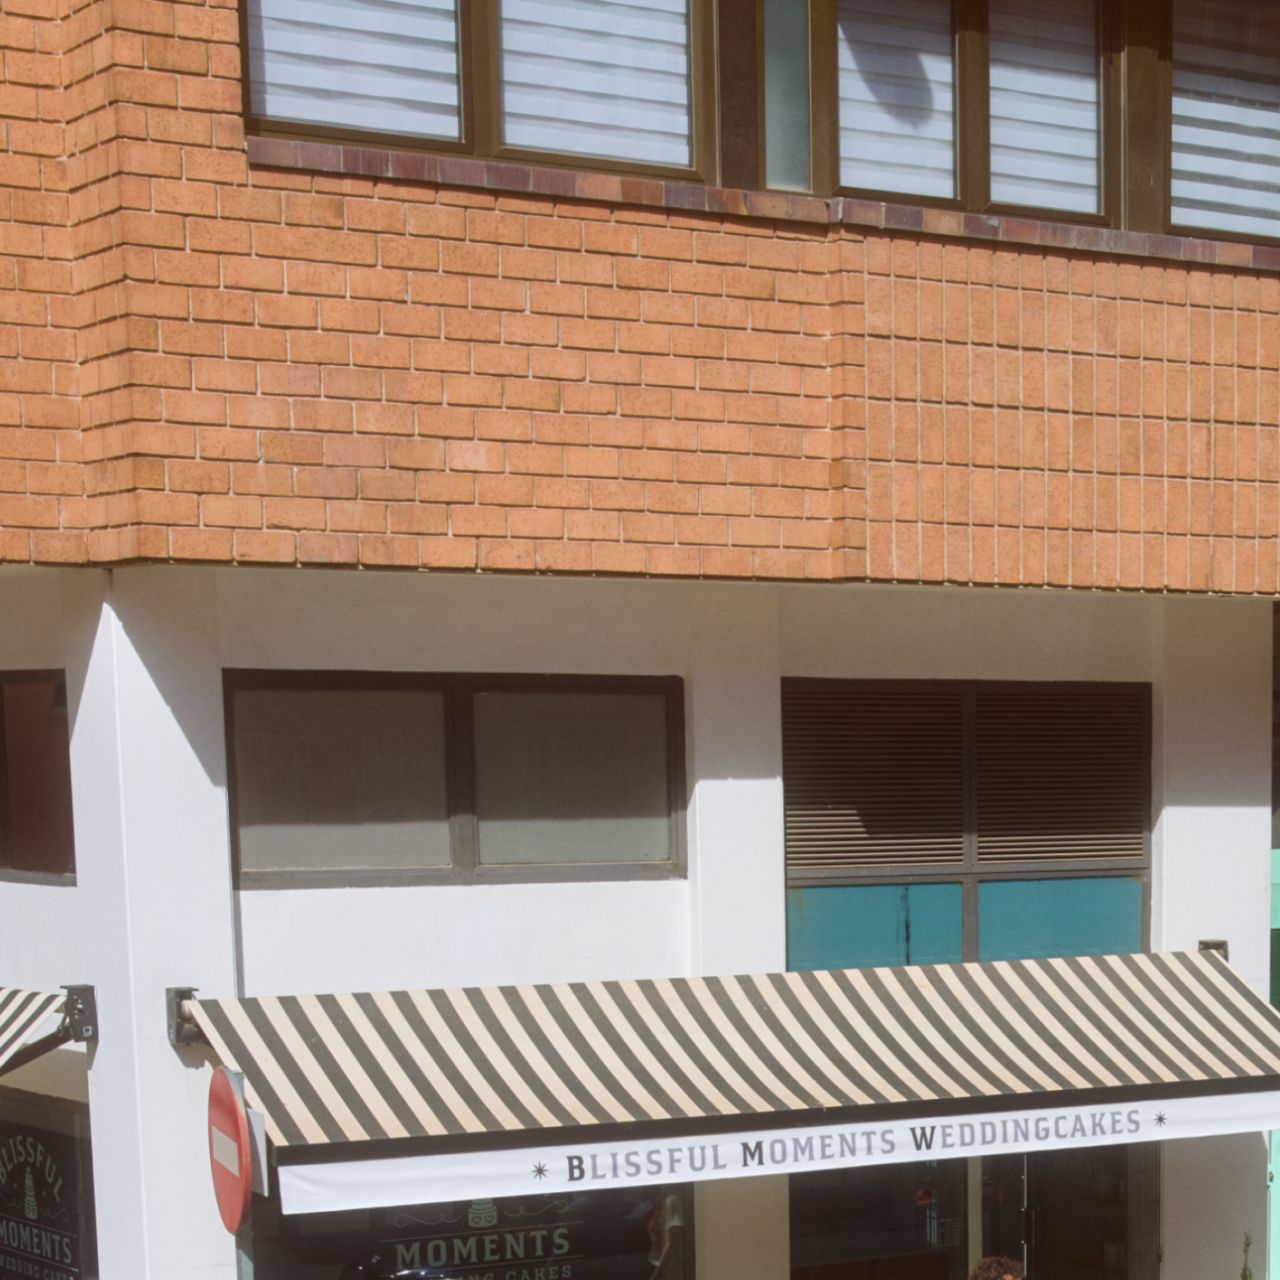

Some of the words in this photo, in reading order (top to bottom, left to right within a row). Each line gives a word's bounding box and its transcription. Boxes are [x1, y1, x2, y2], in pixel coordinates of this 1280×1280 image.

[566, 1144, 727, 1181] BLISSFUL
[740, 1128, 895, 1167] MOMENTS
[910, 1109, 1140, 1151] WEDDINGCAKES
[395, 1228, 570, 1269] MOMENTS
